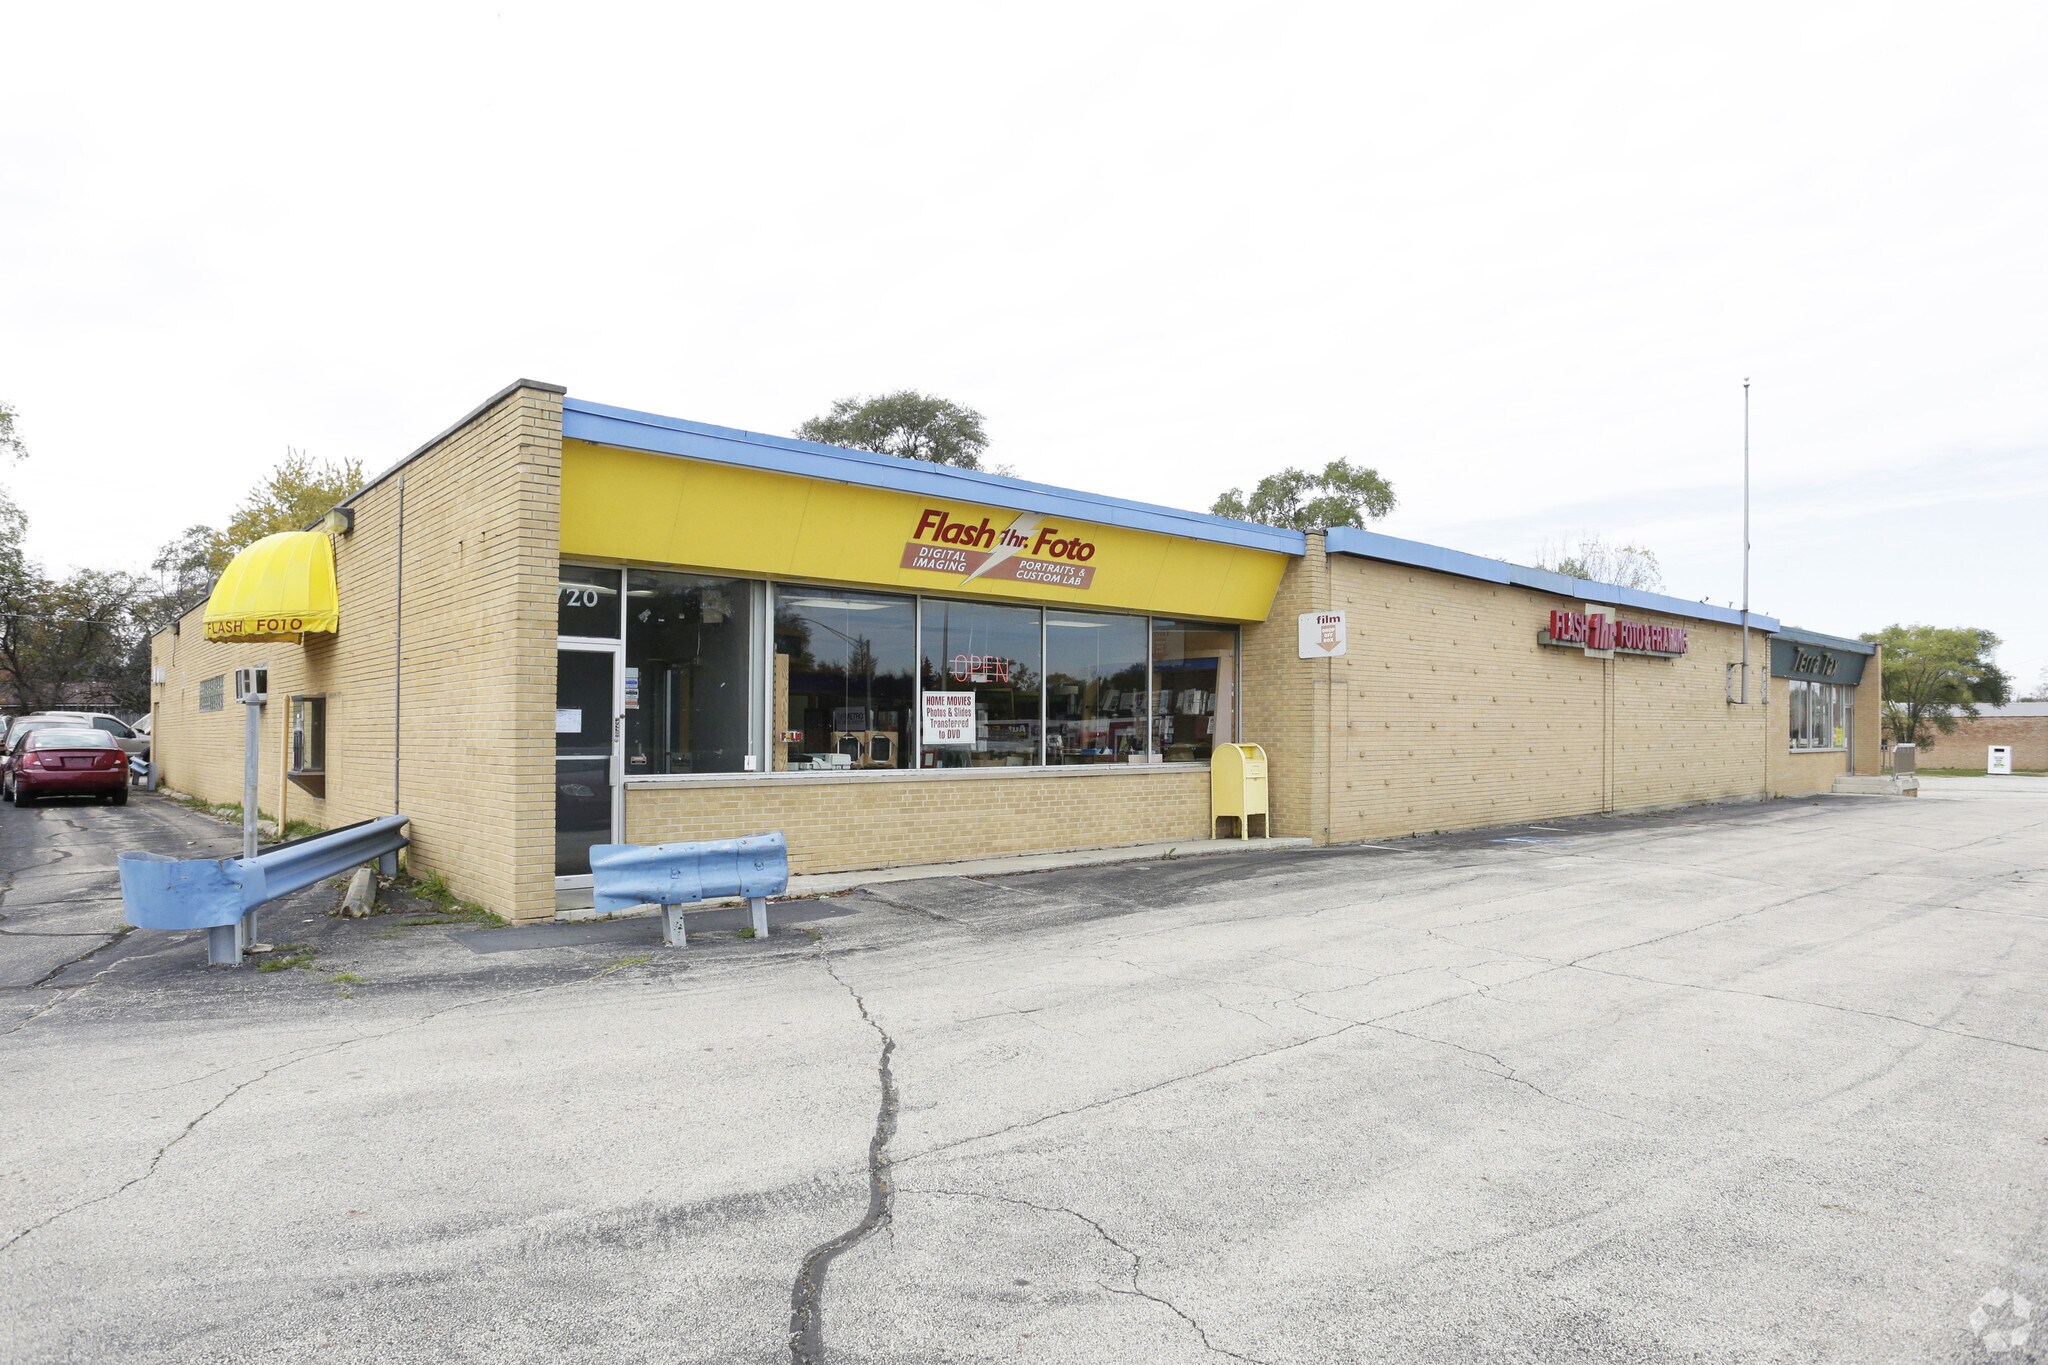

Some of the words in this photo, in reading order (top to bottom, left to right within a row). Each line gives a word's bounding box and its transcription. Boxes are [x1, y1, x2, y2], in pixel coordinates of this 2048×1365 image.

[912, 508, 996, 549] Flash
[1031, 527, 1096, 562] Foto
[919, 547, 967, 562] DIGITAL
[912, 557, 967, 573] IMAGING
[1019, 560, 1076, 576] PORTRAITS
[1080, 568, 1086, 578] &
[1016, 569, 1061, 584] CUSTOM
[1062, 575, 1082, 586] LAB
[1317, 615, 1341, 624] film
[207, 620, 243, 635] FLASH
[1551, 610, 1588, 643] FLASH
[1616, 620, 1644, 650] FOTO
[954, 654, 1009, 683] OPEN
[1793, 646, 1821, 674] Terra
[1822, 652, 1840, 676] Tax
[926, 696, 945, 706] HOME
[946, 696, 972, 706] MOVIES
[926, 707, 946, 718] Photos
[948, 707, 953, 717] &
[953, 707, 972, 717] Slides
[930, 718, 969, 729] Transferred
[938, 730, 945, 740] to
[947, 729, 961, 740] DVD
